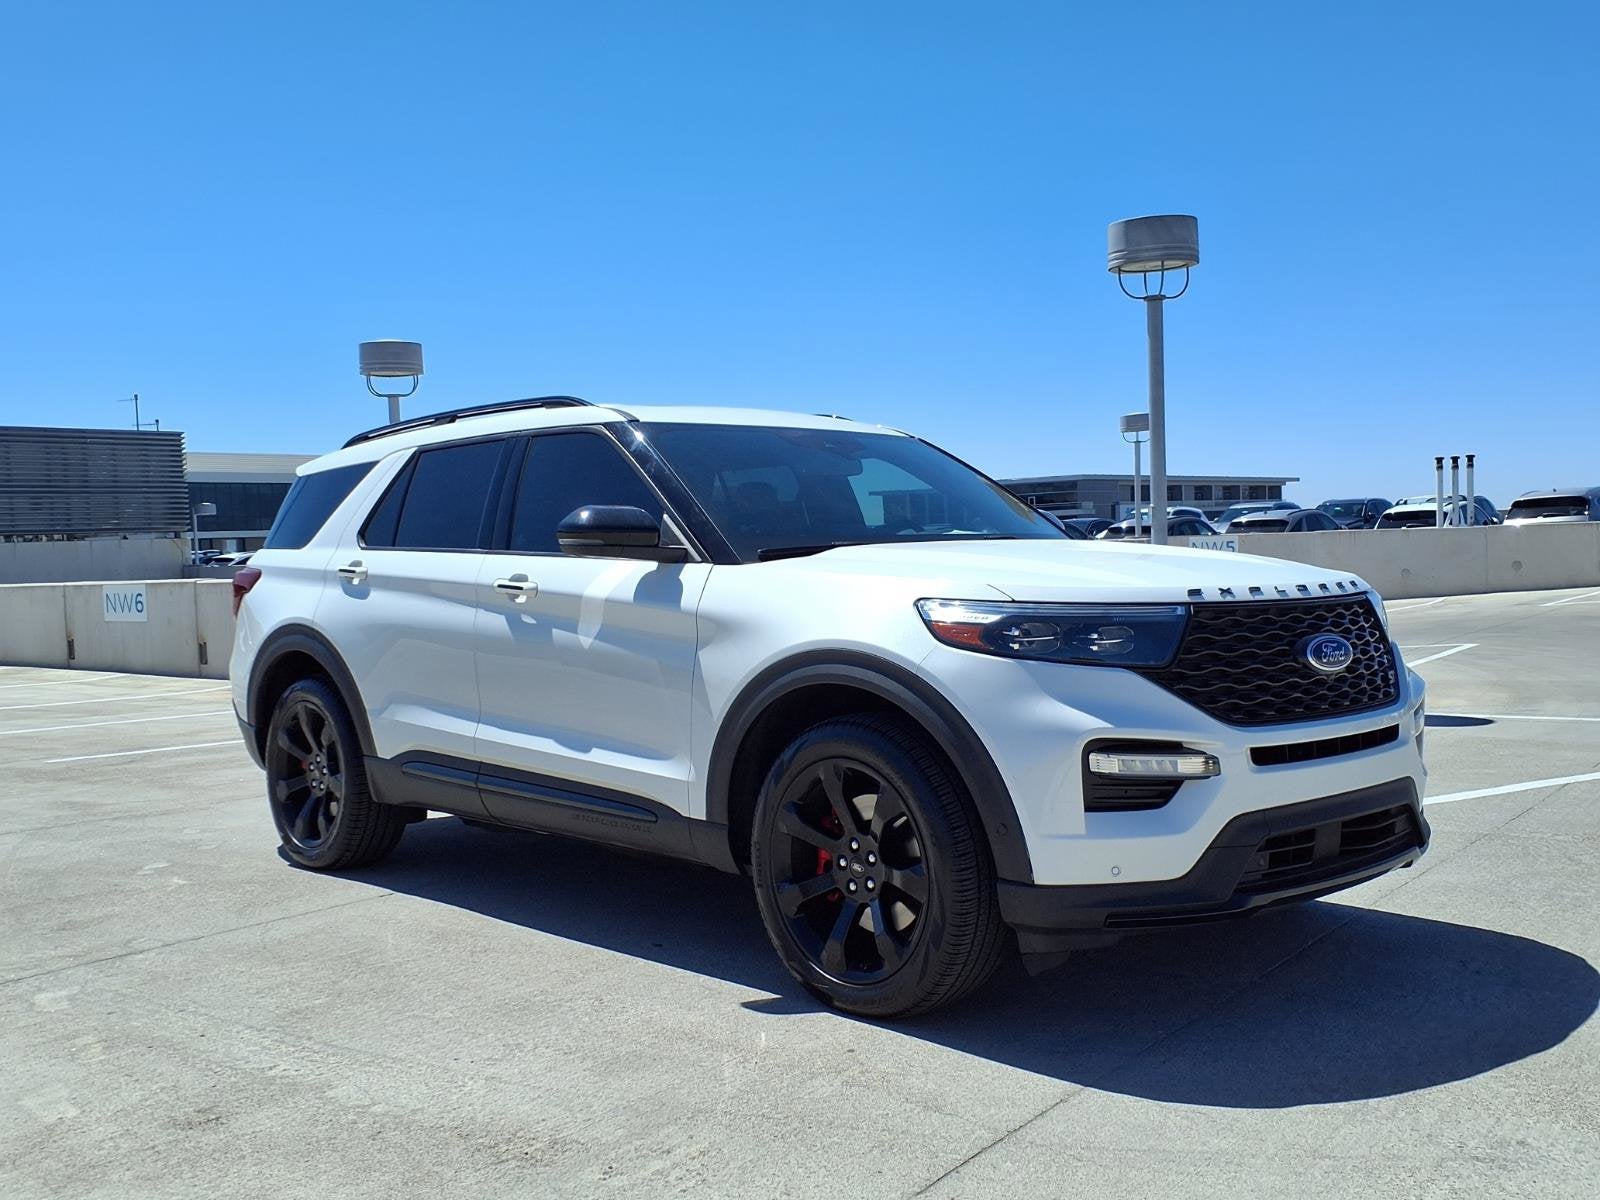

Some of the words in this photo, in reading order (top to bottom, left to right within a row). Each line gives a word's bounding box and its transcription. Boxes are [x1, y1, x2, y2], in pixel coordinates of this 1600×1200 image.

[1187, 580, 1358, 597] EXPLORER
[105, 592, 145, 614] NW6
[1321, 642, 1346, 663] Ford
